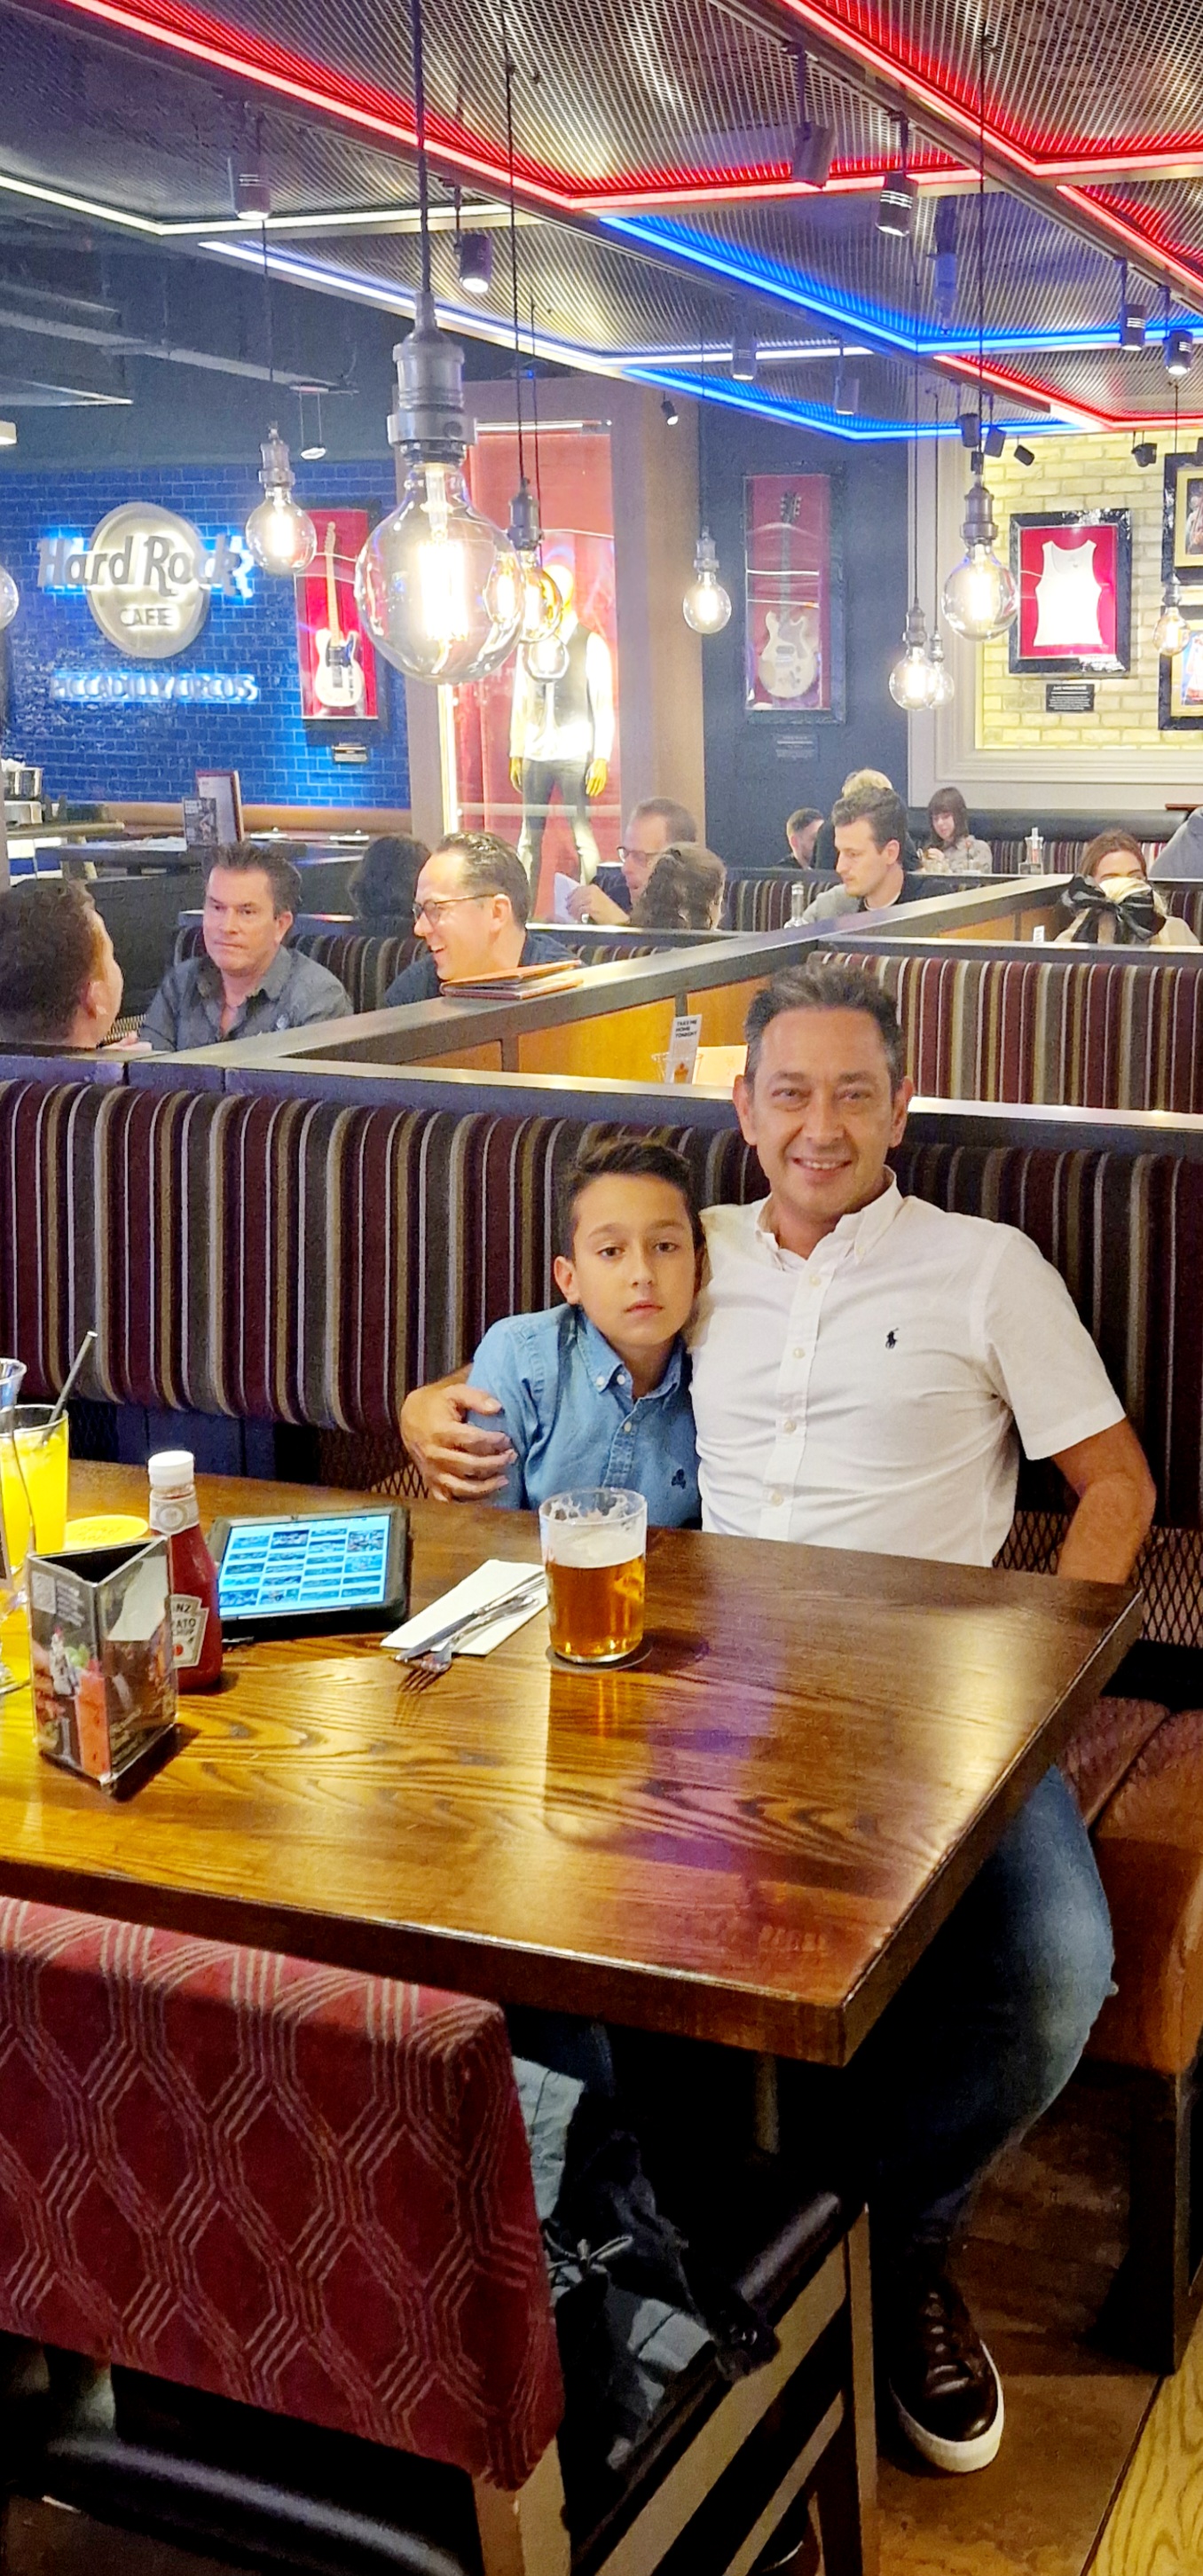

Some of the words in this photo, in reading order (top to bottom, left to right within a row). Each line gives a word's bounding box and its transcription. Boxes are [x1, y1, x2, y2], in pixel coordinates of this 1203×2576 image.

[36, 535, 135, 587] Hard
[142, 534, 252, 598] Rock
[121, 607, 175, 626] CAFE
[51, 673, 176, 701] PICCADILLY
[177, 674, 258, 701] CIRCUS
